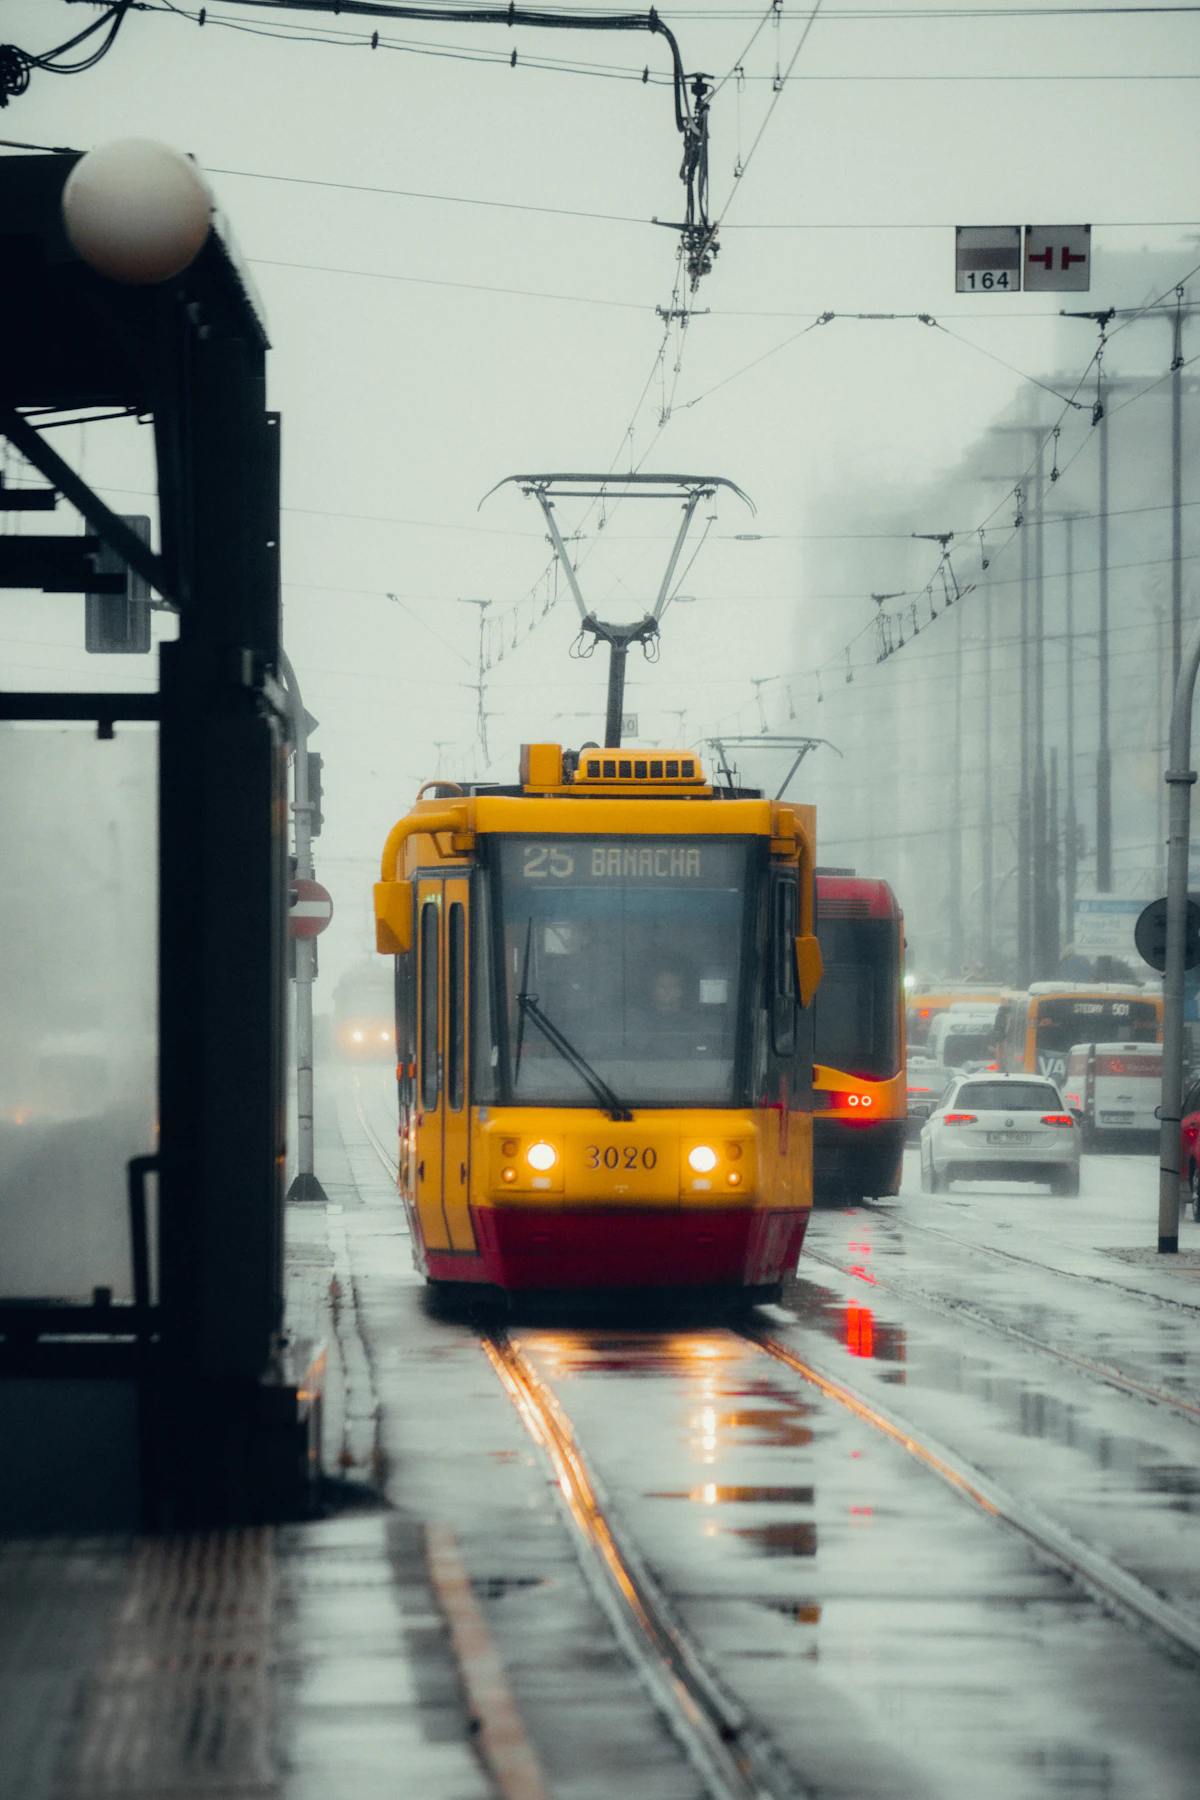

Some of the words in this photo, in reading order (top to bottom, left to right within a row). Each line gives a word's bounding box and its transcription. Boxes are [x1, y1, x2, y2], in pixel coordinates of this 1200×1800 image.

[967, 272, 1009, 289] 164
[523, 848, 574, 877] 25
[591, 849, 701, 876] BANACHA
[1112, 1003, 1130, 1016] 501
[585, 1146, 657, 1170] 3020
